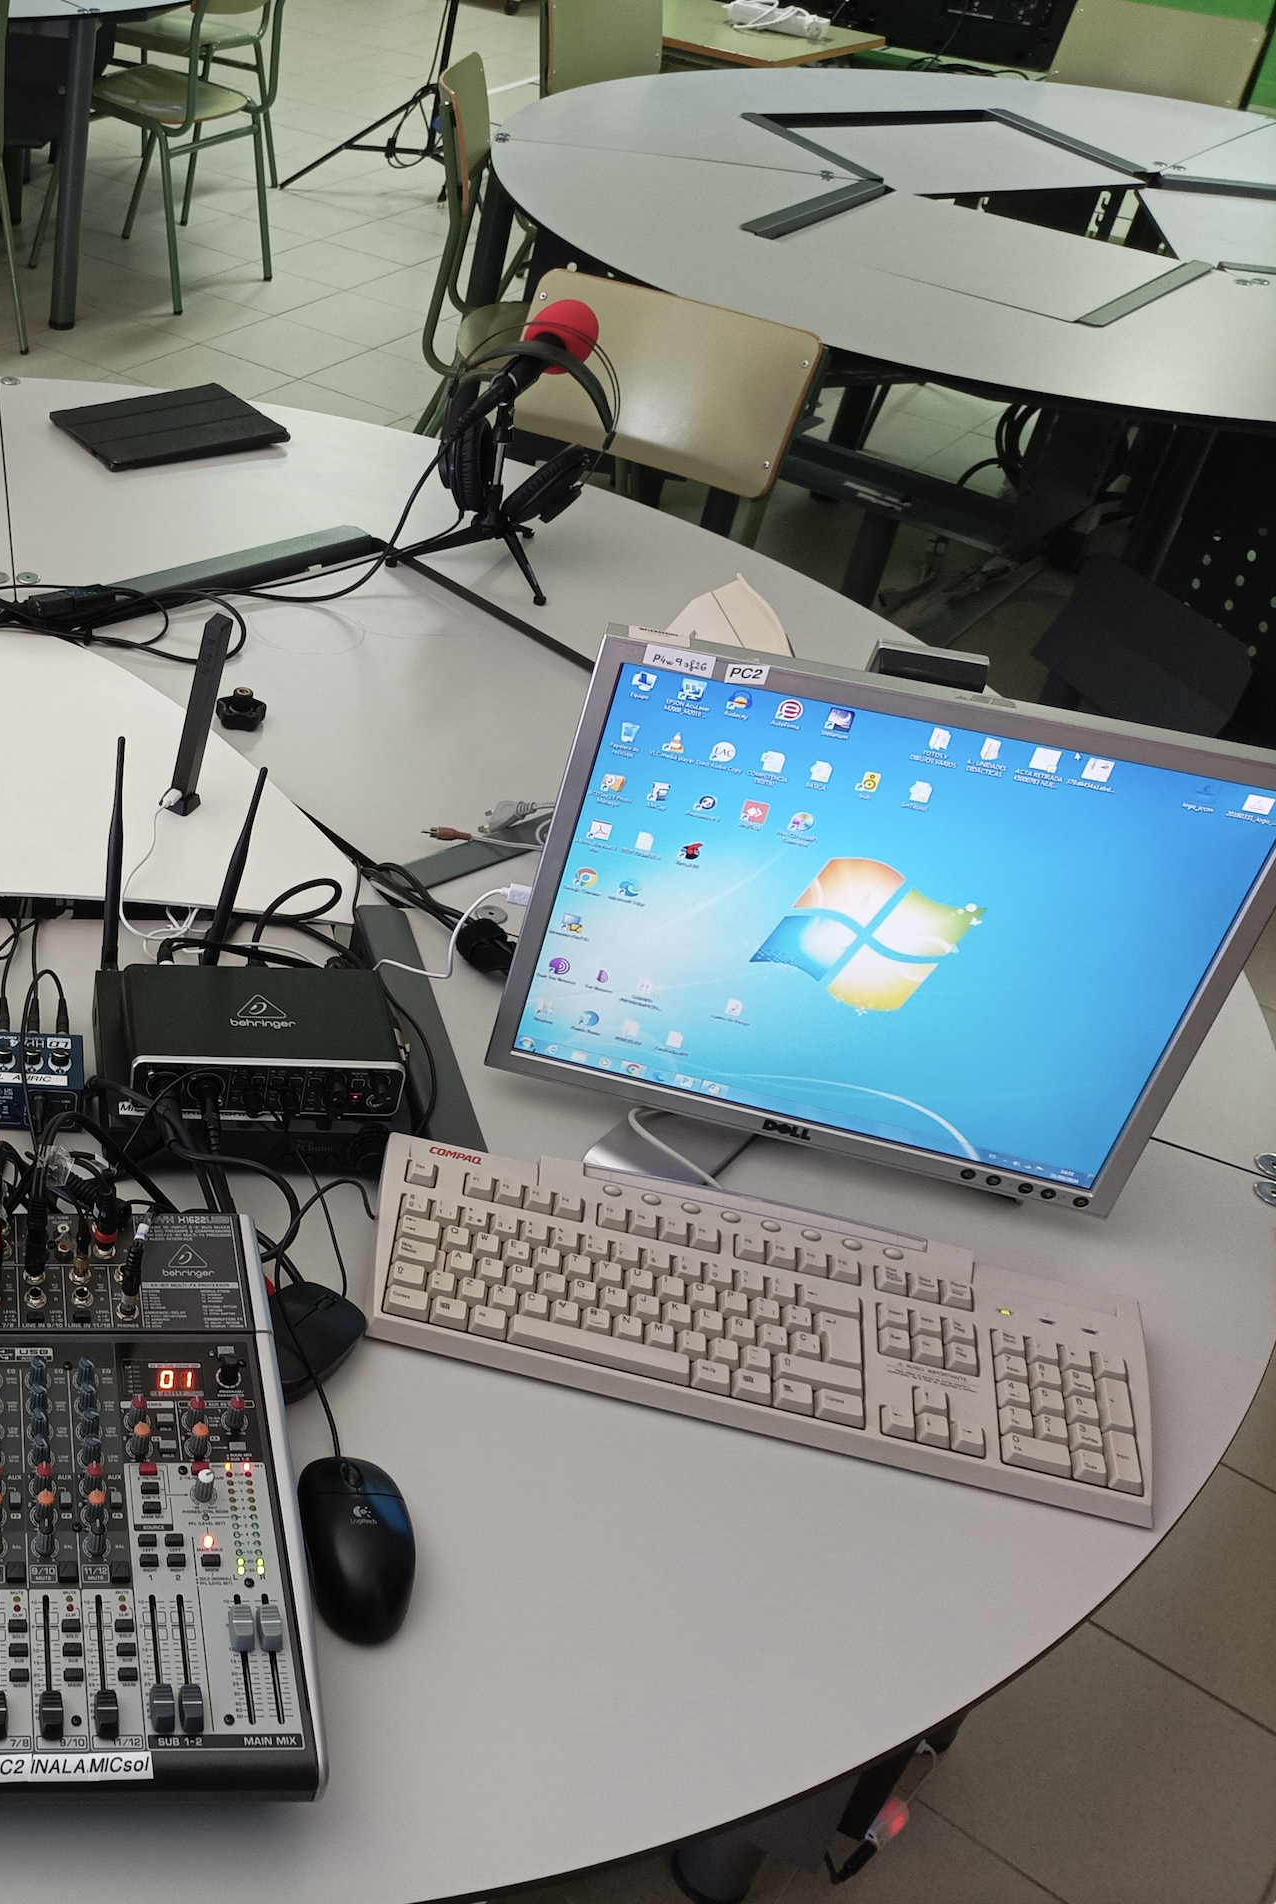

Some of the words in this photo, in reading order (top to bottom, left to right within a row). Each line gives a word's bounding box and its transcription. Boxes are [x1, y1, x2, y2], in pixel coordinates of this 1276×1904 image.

[730, 668, 762, 679] PC2
[630, 692, 649, 700] Equipo
[666, 698, 684, 707] EPSON
[724, 710, 748, 720] Audacity
[770, 720, 800, 730] AutoFirma
[820, 730, 849, 740] Stellarium
[610, 742, 631, 752] Papelera
[612, 749, 634, 758] reciclaje
[661, 752, 677, 760] media
[678, 756, 694, 764] player
[924, 750, 942, 760] FOTOS
[696, 758, 710, 768] Exact
[711, 762, 727, 770] Audio
[728, 766, 742, 775] Copy
[976, 761, 1007, 772] UNIDADES
[746, 770, 788, 784] COMPETENCIA
[1015, 768, 1032, 777] ACTA
[1033, 772, 1064, 784] RETIRADA
[754, 778, 776, 788] DIGITAL
[230, 1018, 296, 1029] behringer
[762, 1119, 810, 1141] DELL
[429, 1146, 482, 1166] COMPAQ
[162, 1268, 214, 1278] behringer
[159, 1370, 193, 1389] 01
[32, 1567, 56, 1576] 9/10
[84, 1566, 108, 1575] 11/12
[10, 1739, 29, 1748] 7/8
[60, 1738, 84, 1748] 9/10
[112, 1738, 141, 1747] 11/12
[158, 1737, 180, 1746] SUB
[184, 1737, 202, 1746] 1-2
[244, 1736, 272, 1746] MAIN
[276, 1736, 298, 1746] MIX
[30, 1759, 89, 1774] INALA
[90, 1757, 149, 1773] MICsol
